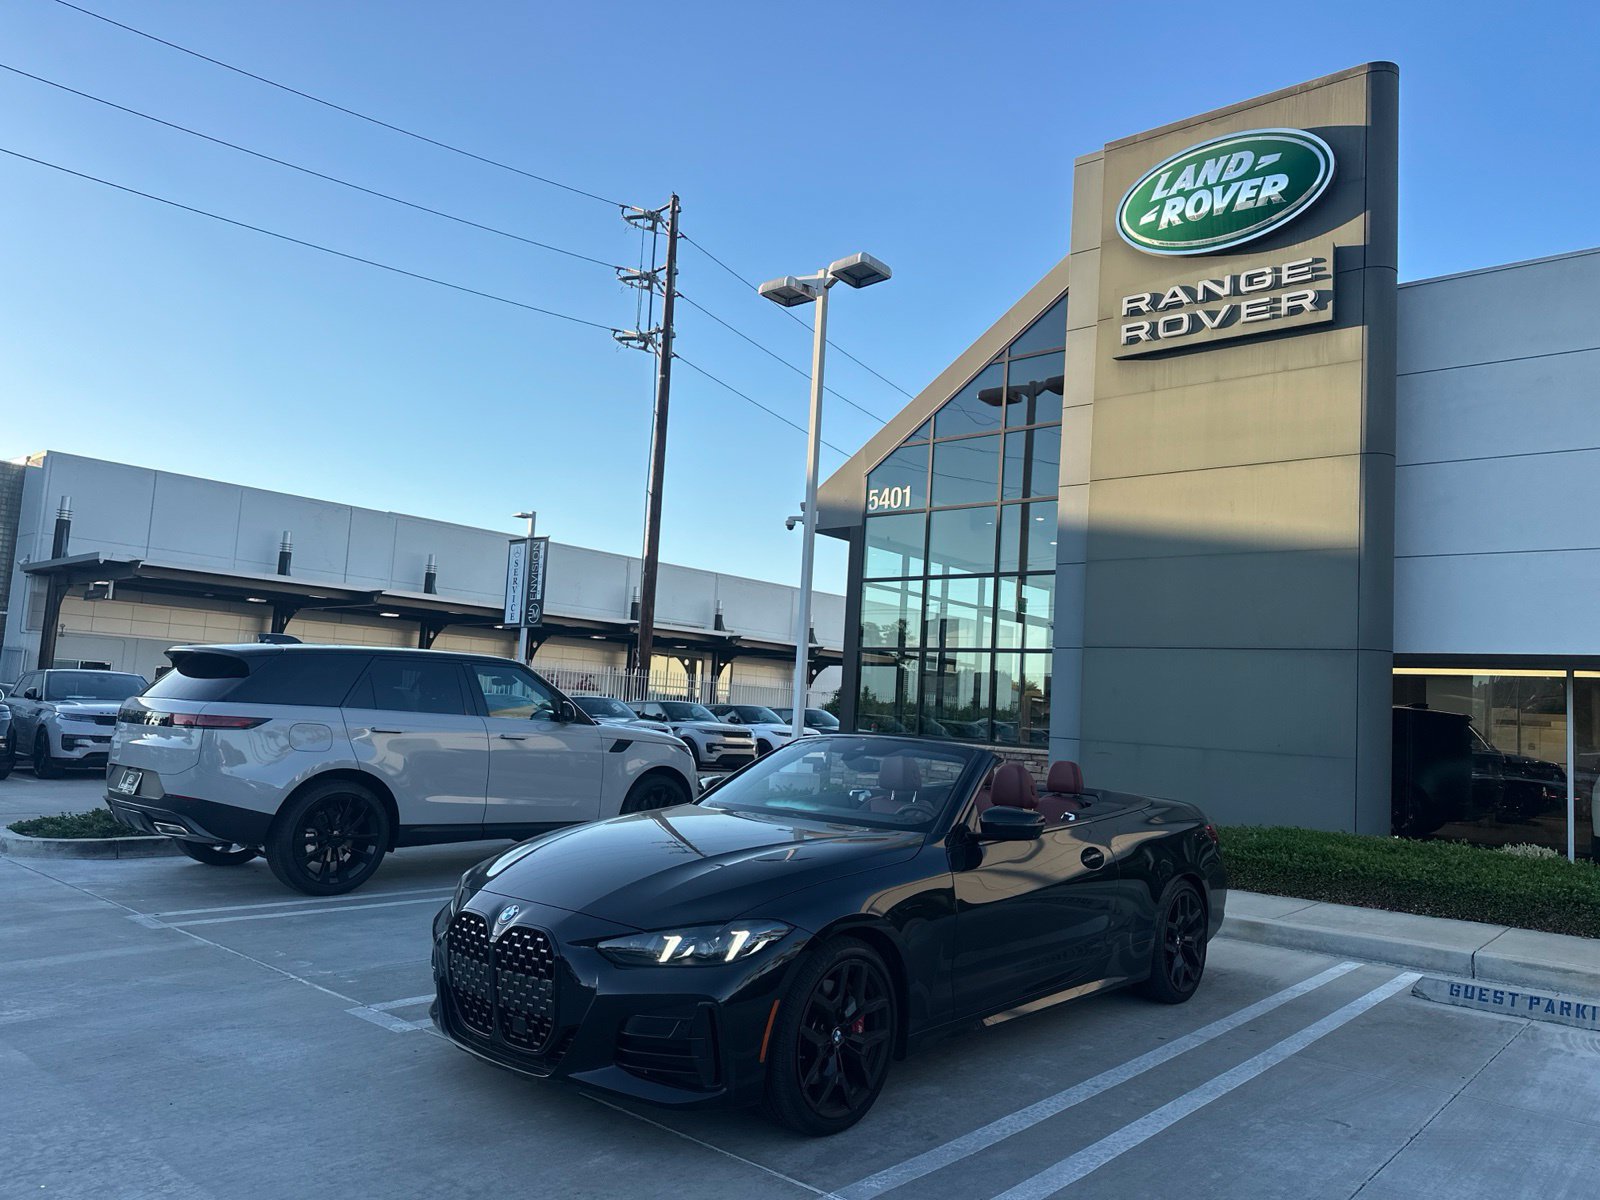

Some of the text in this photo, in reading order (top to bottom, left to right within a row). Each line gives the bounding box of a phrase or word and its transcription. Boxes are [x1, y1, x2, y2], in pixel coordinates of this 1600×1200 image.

[1149, 150, 1255, 202] LAND
[1157, 174, 1289, 230] ROVER
[1121, 257, 1317, 317] RANGE
[1121, 289, 1320, 346] ROVER
[868, 485, 911, 510] 5401
[510, 559, 519, 621] SERVICE
[530, 541, 540, 600] ENVISION
[1450, 983, 1519, 1008] GUEST
